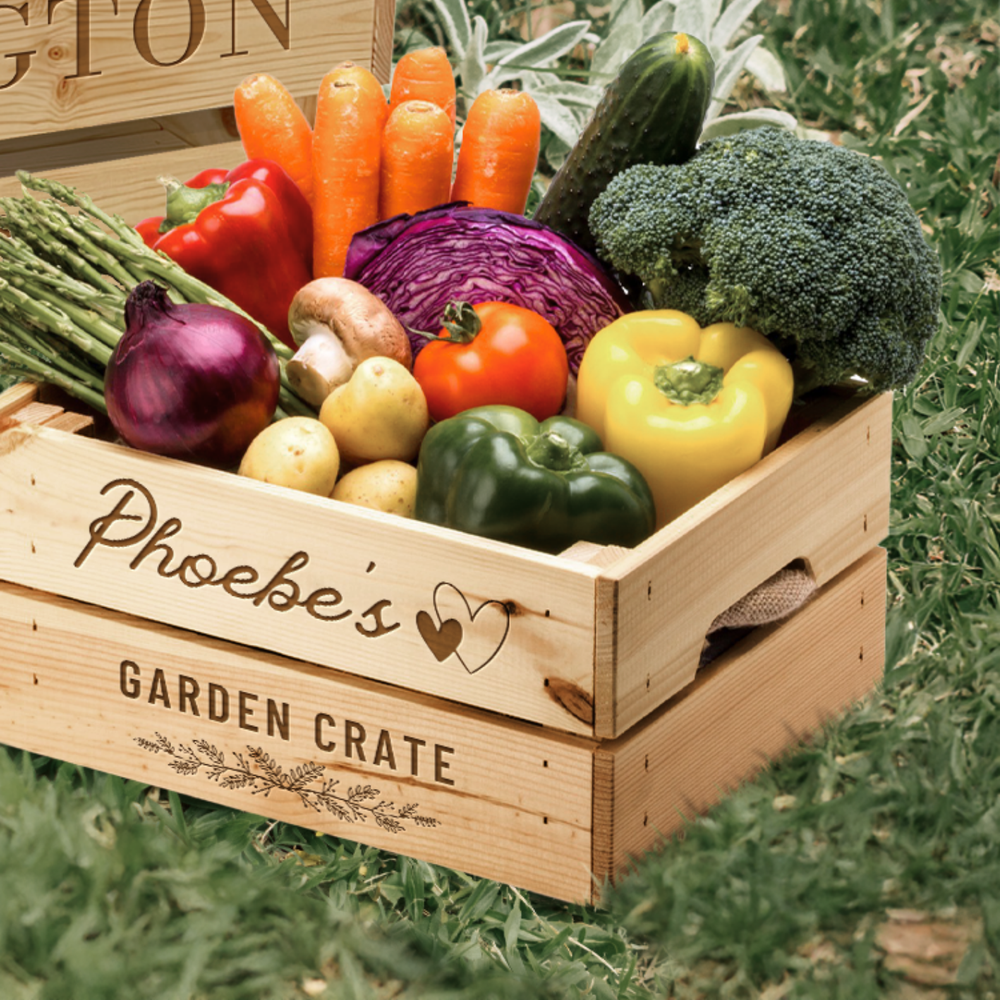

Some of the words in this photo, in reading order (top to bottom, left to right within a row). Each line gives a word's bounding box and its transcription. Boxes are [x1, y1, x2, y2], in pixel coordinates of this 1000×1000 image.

[74, 478, 401, 638] Phoebe's
[119, 659, 290, 741] GARDEN
[314, 712, 455, 786] CRATE
